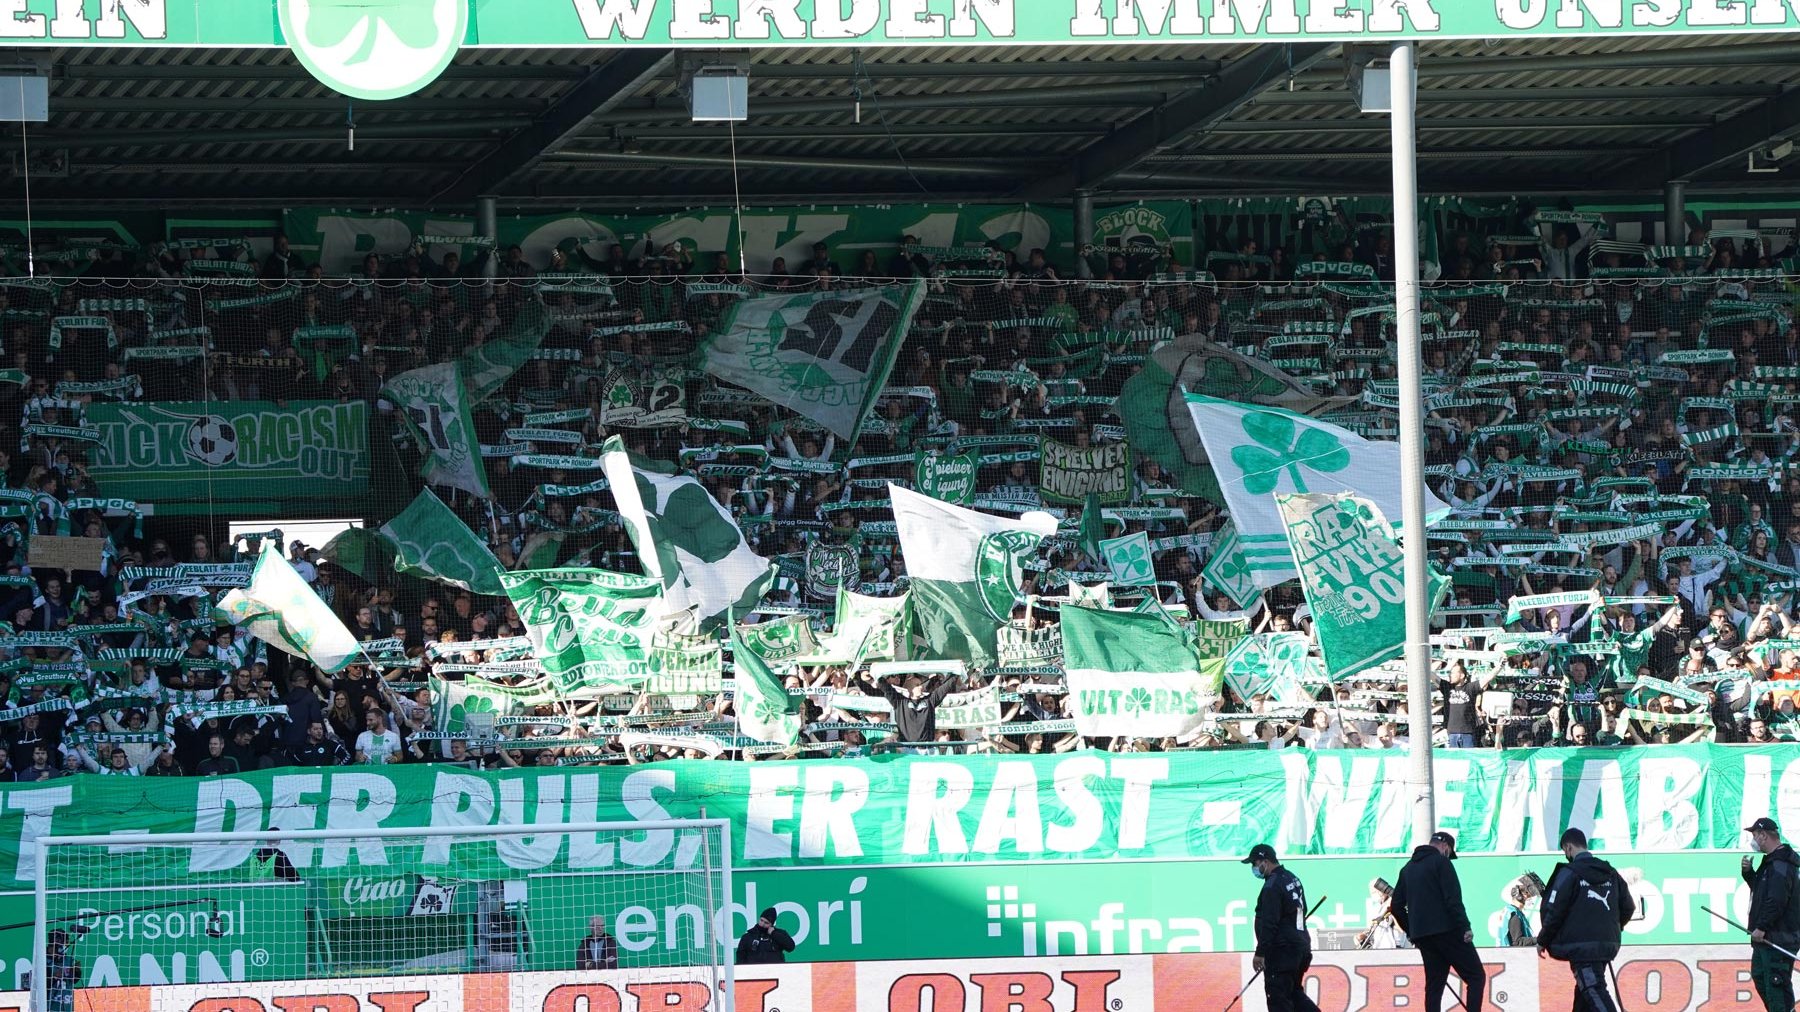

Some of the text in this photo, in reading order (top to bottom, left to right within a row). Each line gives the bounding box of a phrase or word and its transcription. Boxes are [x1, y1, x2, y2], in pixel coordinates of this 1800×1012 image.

[1099, 209, 1165, 233] BLOCK
[1301, 261, 1366, 275] SPVGG
[1668, 352, 1698, 362] SPORTPARK
[1551, 407, 1619, 421] FÜRTH
[47, 426, 80, 435] Greuther
[81, 429, 100, 438] Fürth
[232, 400, 365, 468] RACISM
[490, 442, 528, 454] DEUTSCHER
[299, 445, 359, 481] OUT
[528, 455, 593, 467] SPORTPARK RONHOF
[1690, 464, 1770, 476] RONHOF
[66, 498, 136, 511] SPVGG
[1650, 508, 1704, 520] KLEEBLATT
[1439, 520, 1496, 530] KLEEBLATT FÜRTH
[1510, 541, 1569, 552] KLEEBLATT FÜRTH
[1463, 556, 1520, 566] KLEEBLATT FÜRTH
[184, 563, 218, 574] EEBLATT
[9, 576, 29, 586] Fürth
[1516, 597, 1561, 609] KLEEBLATT
[33, 663, 50, 672] MEIN
[1038, 665, 1061, 675] 1000
[36, 673, 67, 685] Greuther
[38, 699, 69, 712] FÜRTH
[1079, 687, 1201, 717] ULT RAS
[816, 722, 865, 732] HORIDOS
[78, 732, 160, 745] FÜRTH
[418, 731, 469, 741] HORIDOS
[188, 770, 398, 874] DER
[743, 764, 870, 860] ER
[901, 755, 1169, 857] RAST
[1494, 756, 1703, 853] HAB
[342, 876, 406, 905] Ciao
[76, 900, 245, 944] Personal
